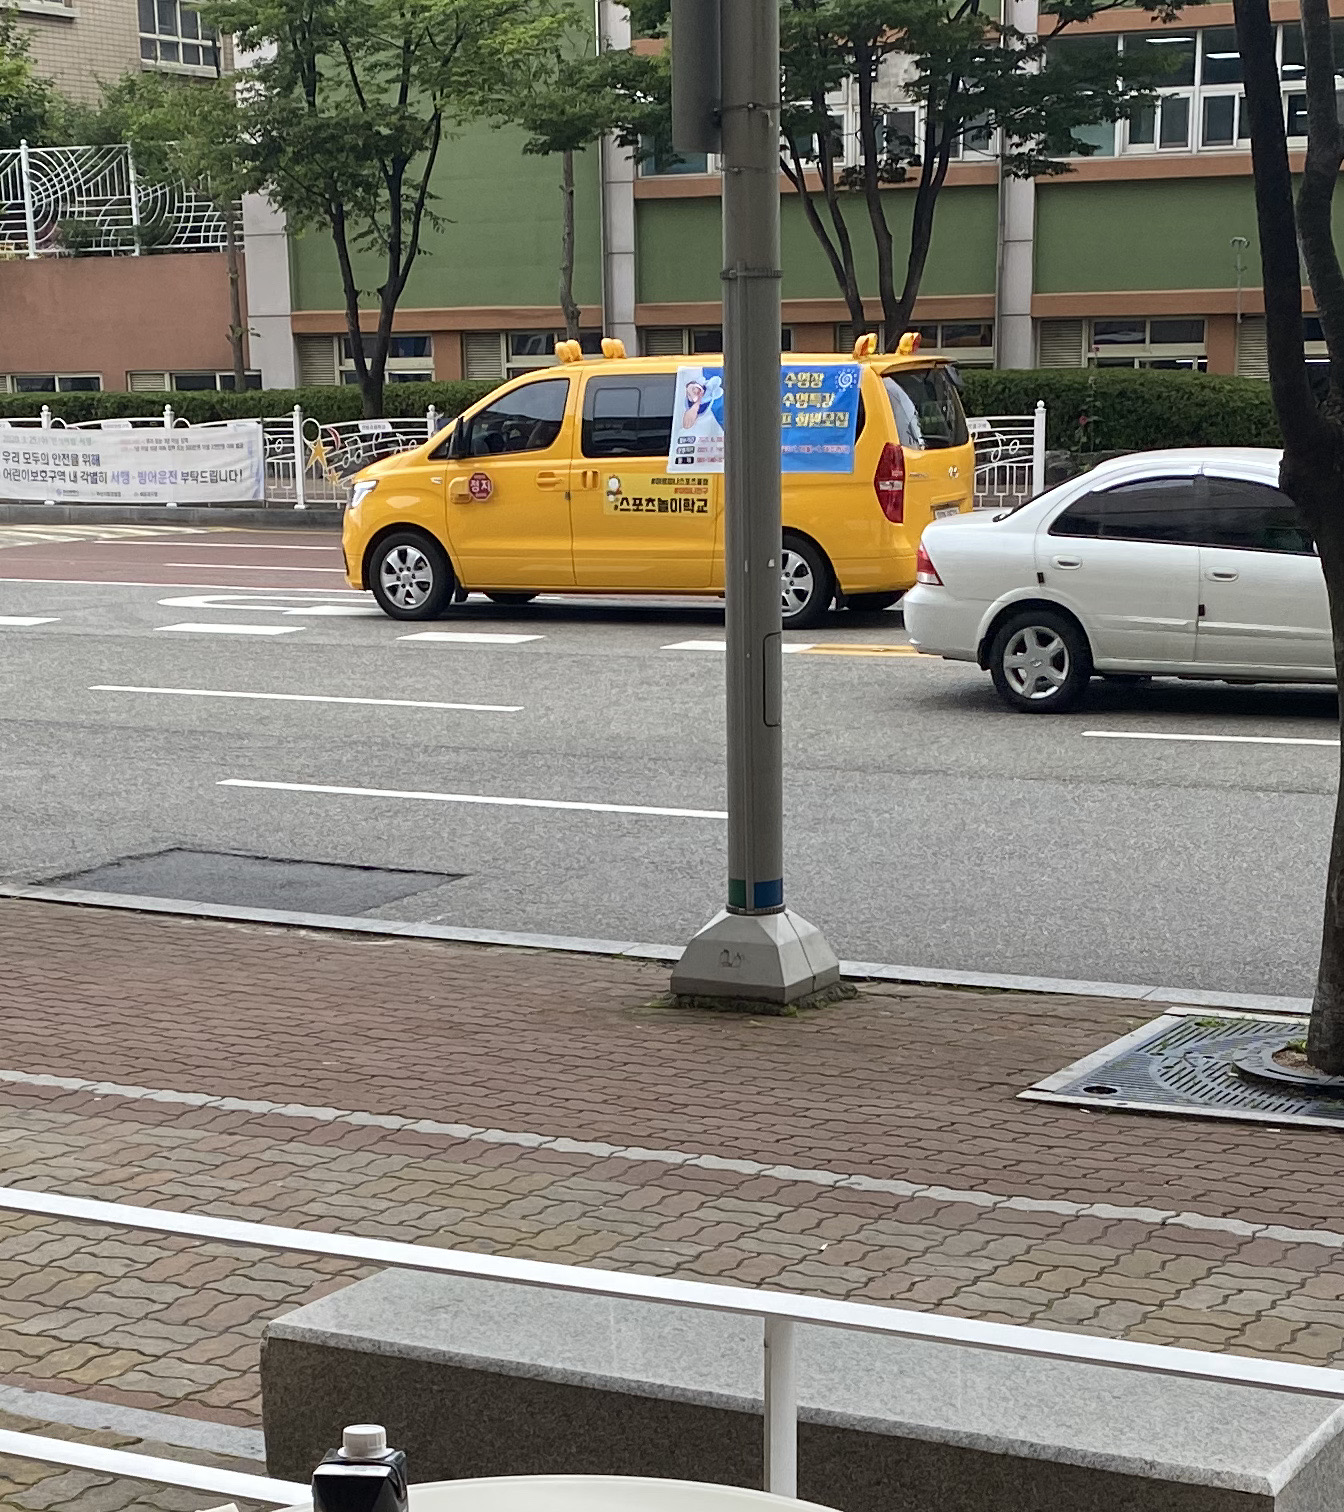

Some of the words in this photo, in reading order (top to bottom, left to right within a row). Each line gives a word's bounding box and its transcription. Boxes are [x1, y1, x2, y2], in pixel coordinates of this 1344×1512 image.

[2, 450, 20, 465] 우리
[22, 451, 50, 466] 모두의
[51, 453, 79, 467] 안전을
[81, 453, 101, 467] 위해
[2, 468, 66, 483] 어린이보호구역
[68, 470, 78, 483] 내
[80, 471, 108, 485] 각별히
[180, 468, 244, 485] 부탁드립니다!
[470, 479, 491, 493] 정지
[619, 496, 709, 514] 스포츠놀이학교
